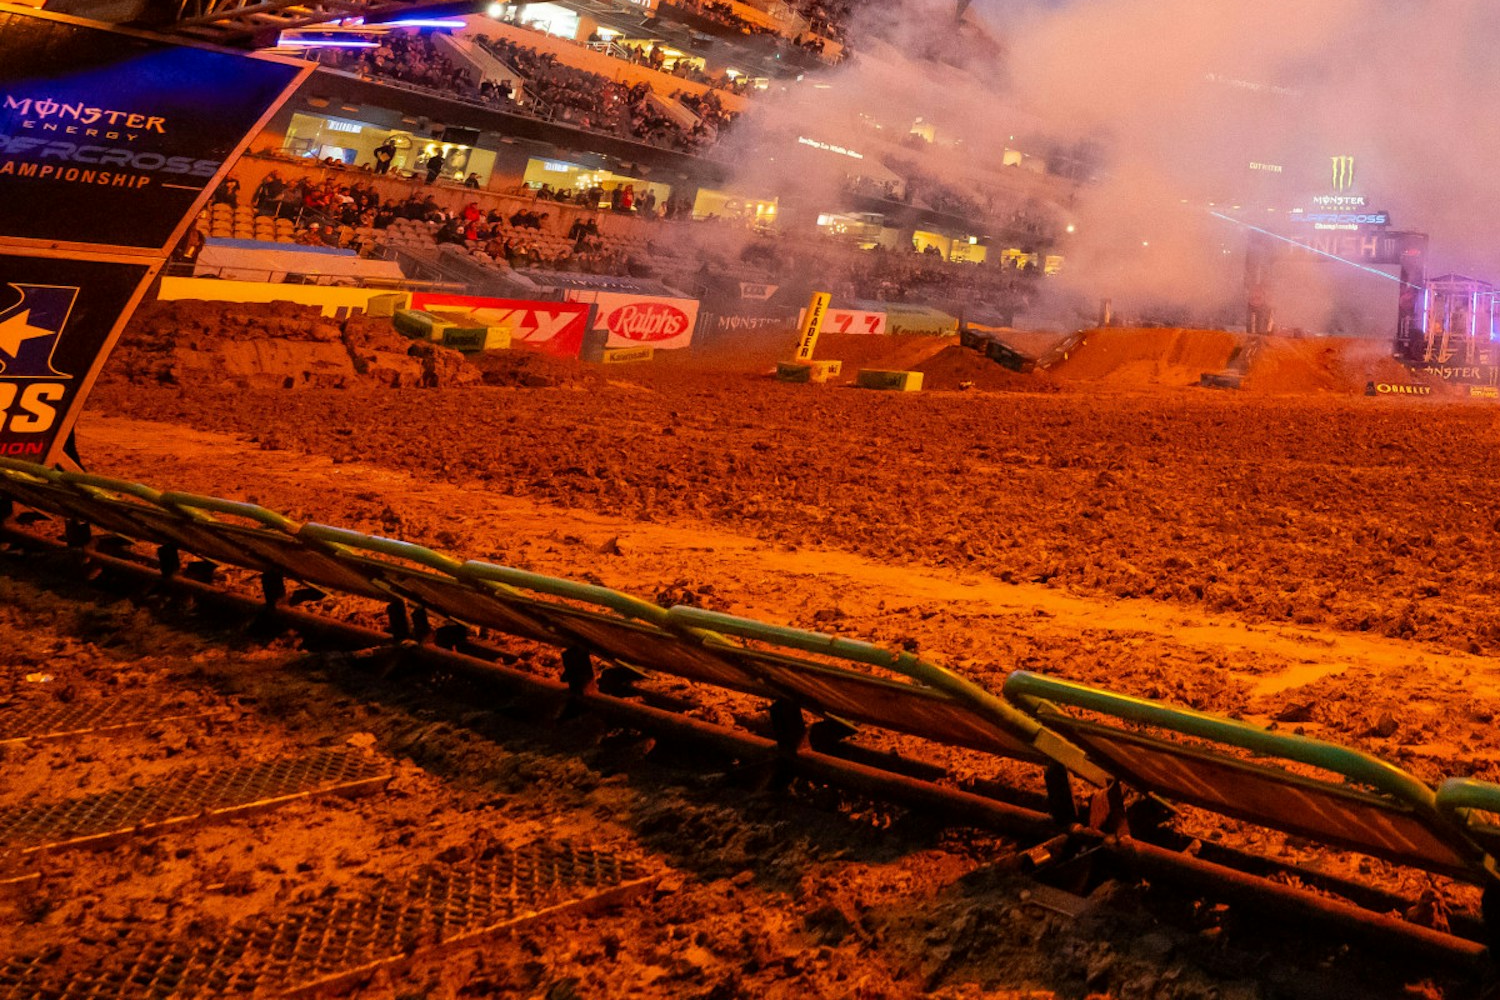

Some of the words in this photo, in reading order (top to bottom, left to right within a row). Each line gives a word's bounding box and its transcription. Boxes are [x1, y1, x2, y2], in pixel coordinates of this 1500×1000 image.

[3, 95, 167, 134] MONSTER
[22, 120, 139, 142] ENERGY
[0, 160, 151, 189] AMPIONSHIP
[1313, 195, 1365, 206] MONSTER
[614, 304, 683, 340] Ralphs
[1391, 384, 1431, 395] OAKLEY
